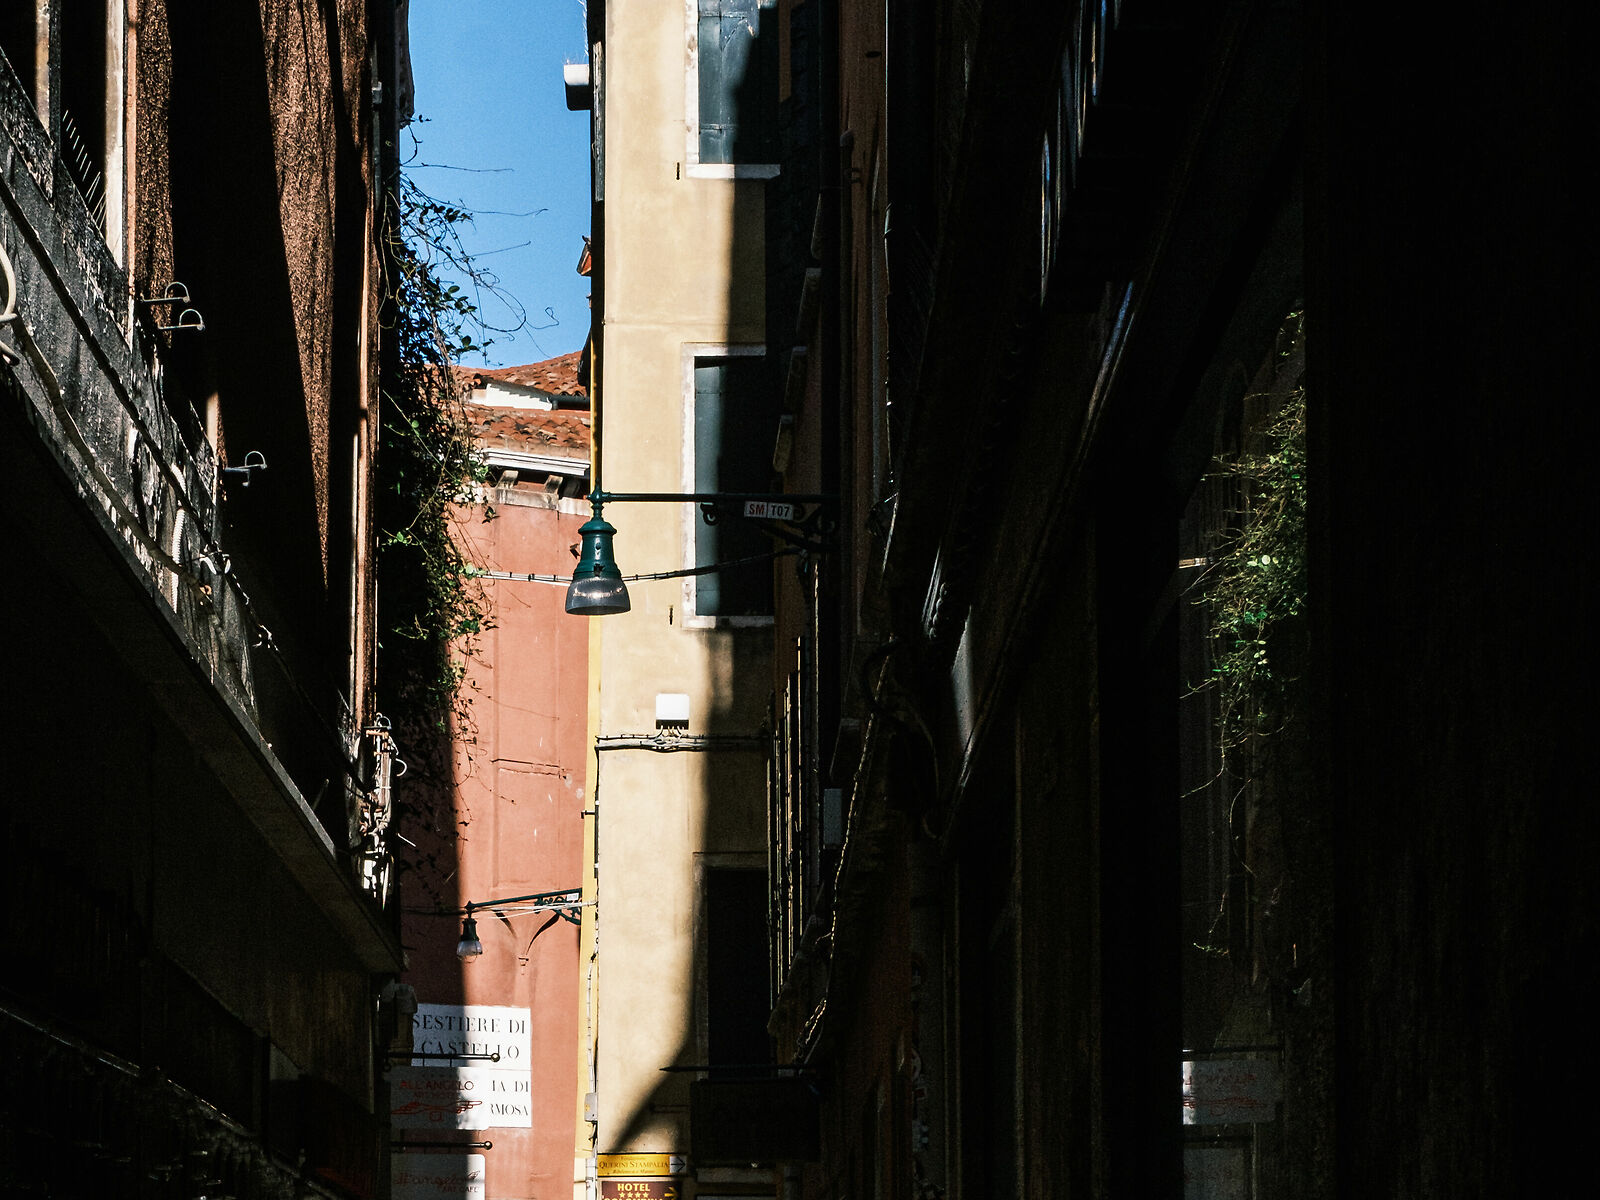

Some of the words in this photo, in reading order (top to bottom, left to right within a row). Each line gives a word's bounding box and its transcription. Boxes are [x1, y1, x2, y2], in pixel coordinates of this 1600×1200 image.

[749, 503, 765, 515] SM
[411, 1014, 501, 1033] SESTIERE
[508, 1019, 525, 1034] DI
[514, 1081, 529, 1092] DI
[617, 1183, 651, 1192] HOTEL
